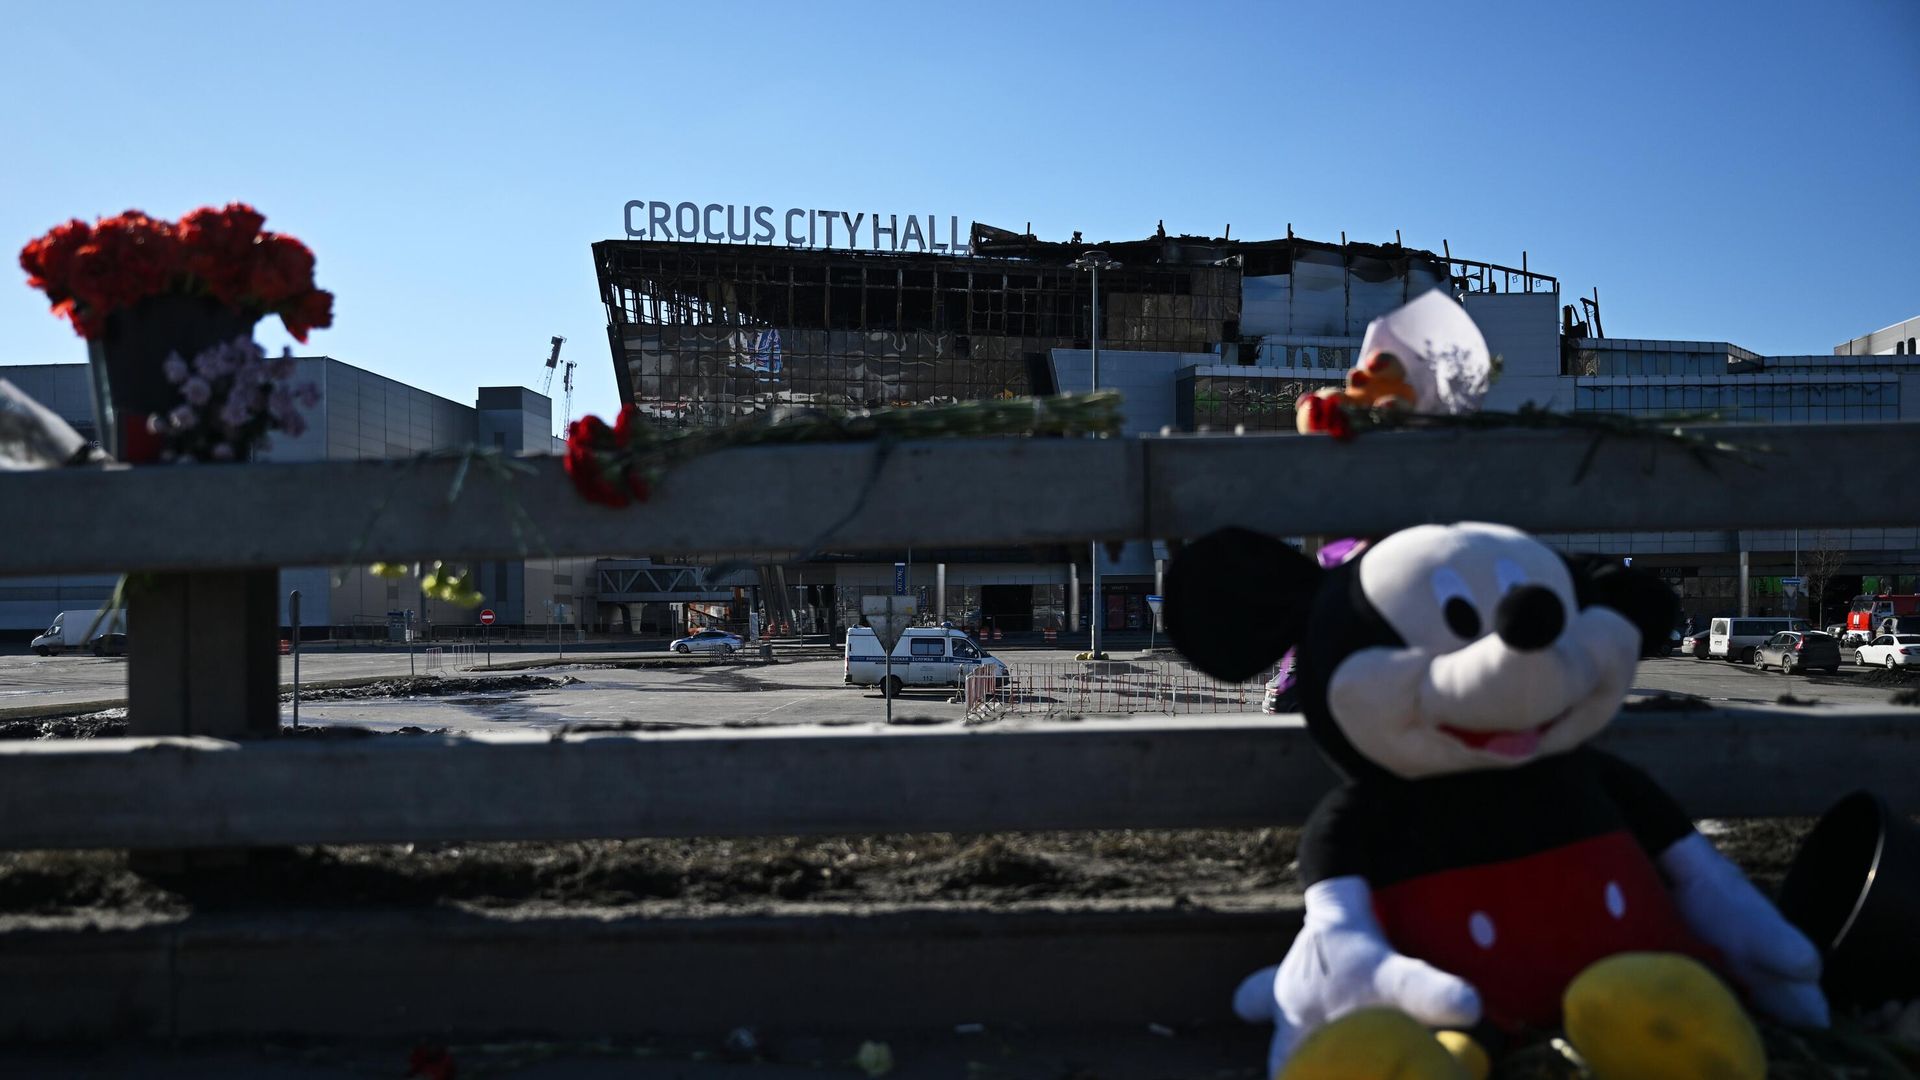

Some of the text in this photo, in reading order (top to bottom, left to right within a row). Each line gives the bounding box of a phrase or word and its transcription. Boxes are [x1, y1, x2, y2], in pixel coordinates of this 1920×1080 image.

[624, 200, 970, 250] CROCUS CITY HALL
